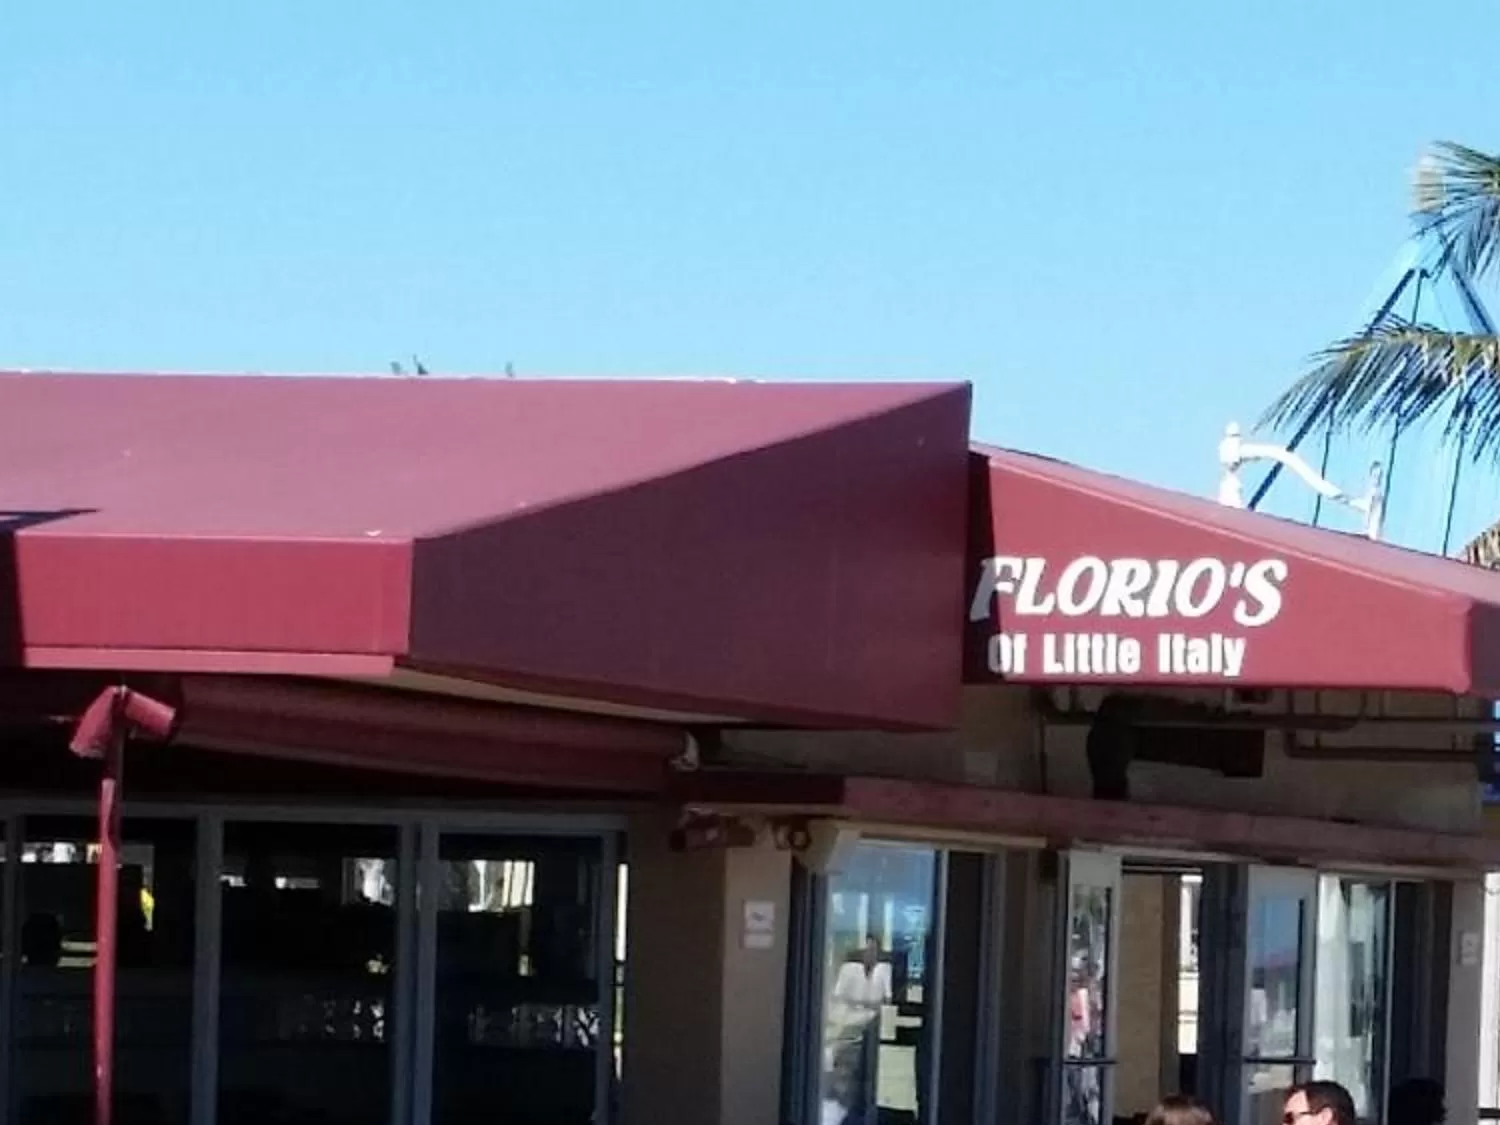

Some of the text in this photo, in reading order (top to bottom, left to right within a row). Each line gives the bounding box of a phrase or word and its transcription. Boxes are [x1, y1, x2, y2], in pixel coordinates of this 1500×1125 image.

[969, 555, 1287, 627] FLORIO'S
[988, 632, 1246, 677] Of Little Italy
